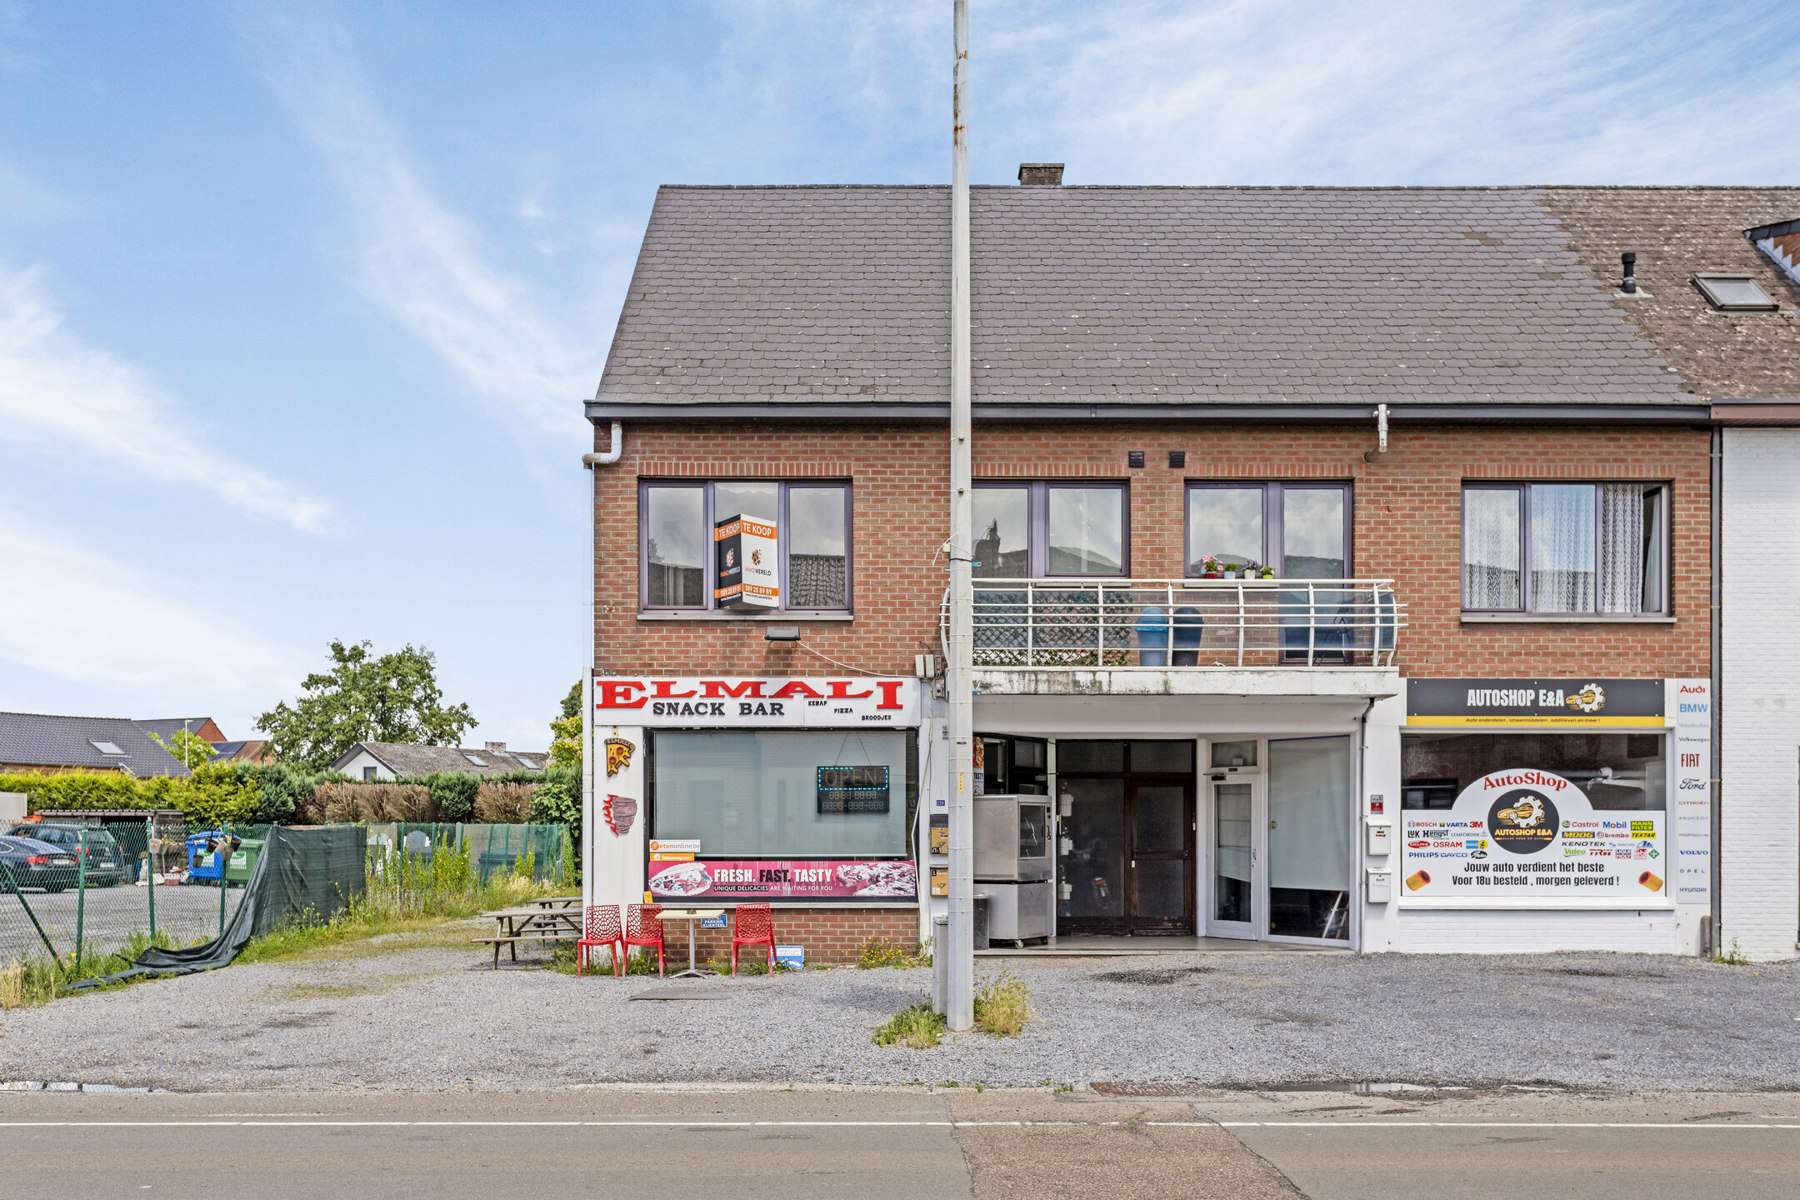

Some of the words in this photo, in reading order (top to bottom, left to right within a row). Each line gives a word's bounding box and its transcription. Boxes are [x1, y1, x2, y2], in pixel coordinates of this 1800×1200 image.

[743, 523, 751, 532] TE
[753, 525, 772, 537] KOOP
[596, 681, 903, 710] ELMALI
[1680, 685, 1705, 693] Audi
[1467, 689, 1535, 706] AUTOSHOP
[1538, 689, 1564, 707] E&A
[652, 702, 726, 716] SNACK
[739, 703, 785, 716] BAR
[1680, 703, 1708, 712] BMW
[1681, 754, 1700, 767] FIAT
[825, 768, 877, 788] OPEN
[1483, 772, 1567, 791] AutoShop
[1680, 779, 1706, 790] Ford
[1603, 821, 1626, 829] Mobil
[1464, 862, 1490, 873] Jouw
[1493, 862, 1514, 873] auto
[1517, 862, 1557, 873] verdient
[1559, 862, 1575, 873] het
[1578, 862, 1604, 873] beste
[714, 869, 756, 883] FRESH.
[759, 869, 791, 884] FAST.
[794, 869, 832, 883] TASTY
[1452, 875, 1475, 886] Voor
[1476, 875, 1490, 886] 18u
[1493, 875, 1528, 886] besteld
[1536, 877, 1572, 888] morgen
[1574, 875, 1614, 888] geleverd
